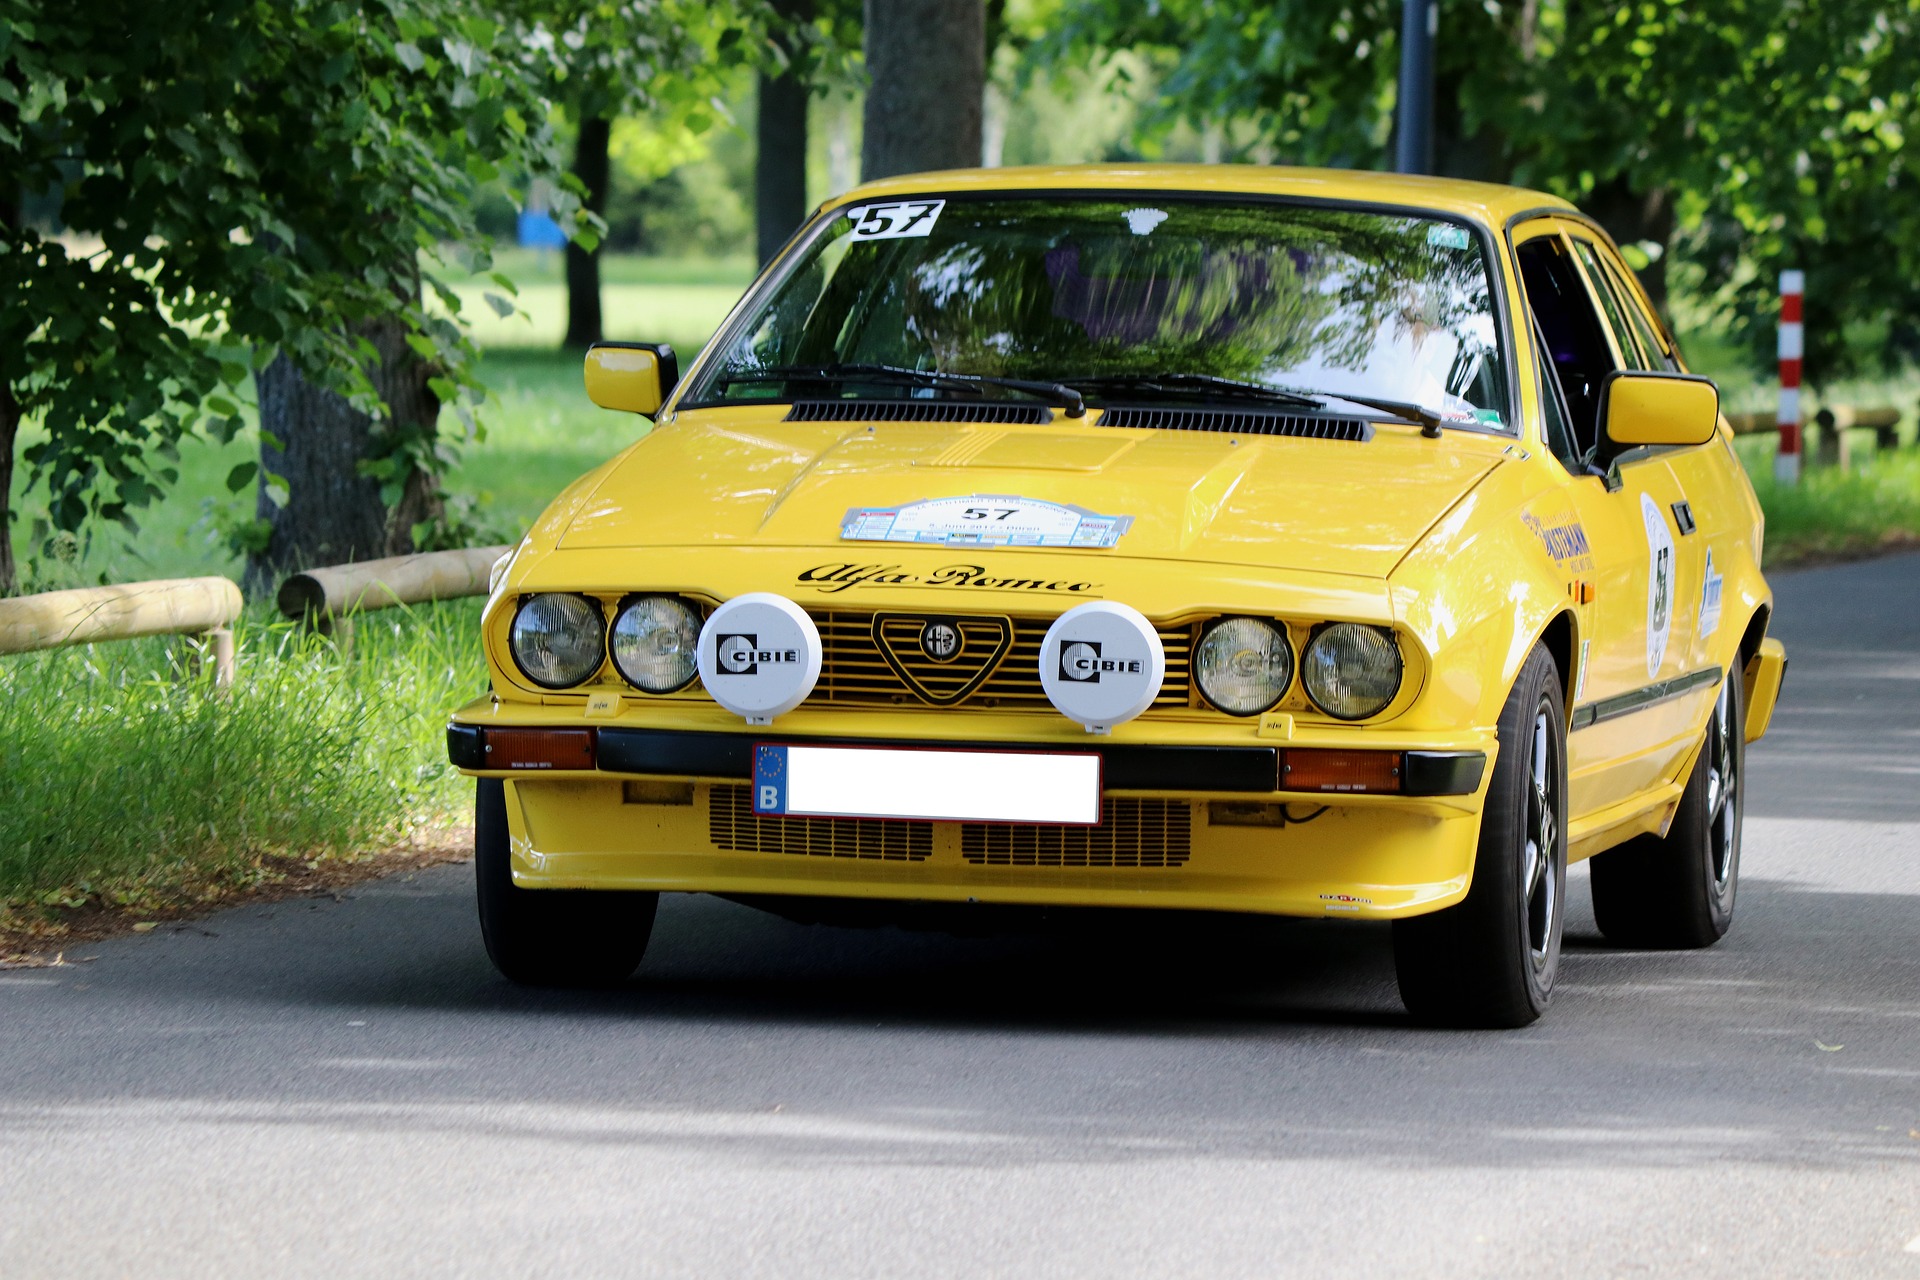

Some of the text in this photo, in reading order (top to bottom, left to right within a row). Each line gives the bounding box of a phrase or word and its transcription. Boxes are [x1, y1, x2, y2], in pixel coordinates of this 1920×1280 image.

[858, 203, 941, 235] 57
[961, 508, 1020, 521] 57
[797, 563, 1104, 593] Alfa Romeo
[759, 785, 778, 810] B
